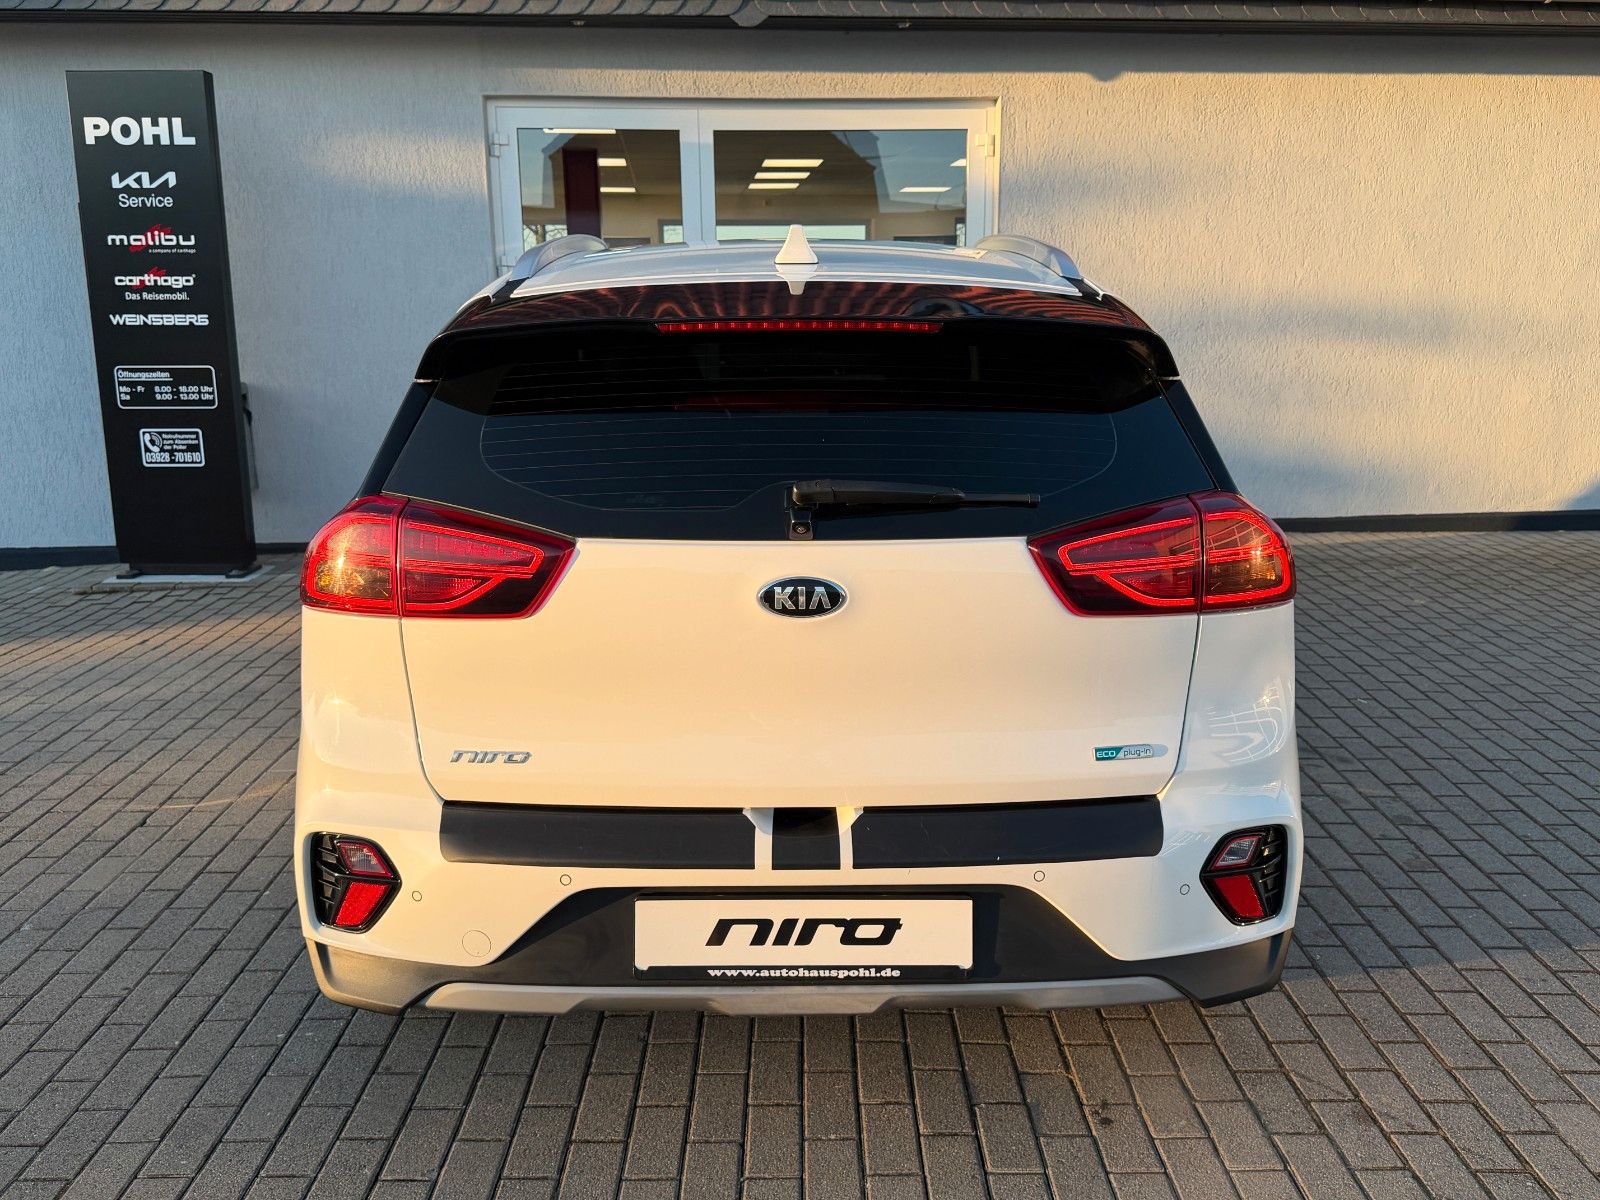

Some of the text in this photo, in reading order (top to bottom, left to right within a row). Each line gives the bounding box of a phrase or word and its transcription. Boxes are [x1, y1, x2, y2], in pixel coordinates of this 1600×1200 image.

[83, 116, 196, 145] POHL
[111, 171, 177, 189] KIA
[118, 193, 174, 208] Service
[107, 230, 196, 246] malibu
[114, 273, 194, 288] carthago
[125, 292, 189, 300] Das Reisemobil.
[109, 314, 209, 326] WEINSBERG
[117, 369, 170, 379] Öffnungszeiten
[773, 586, 832, 610] KIA
[450, 750, 532, 763] niro
[1096, 748, 1151, 758] ECO plug-in
[705, 917, 904, 946] niro
[707, 967, 901, 979] www.autohauspohl.de
